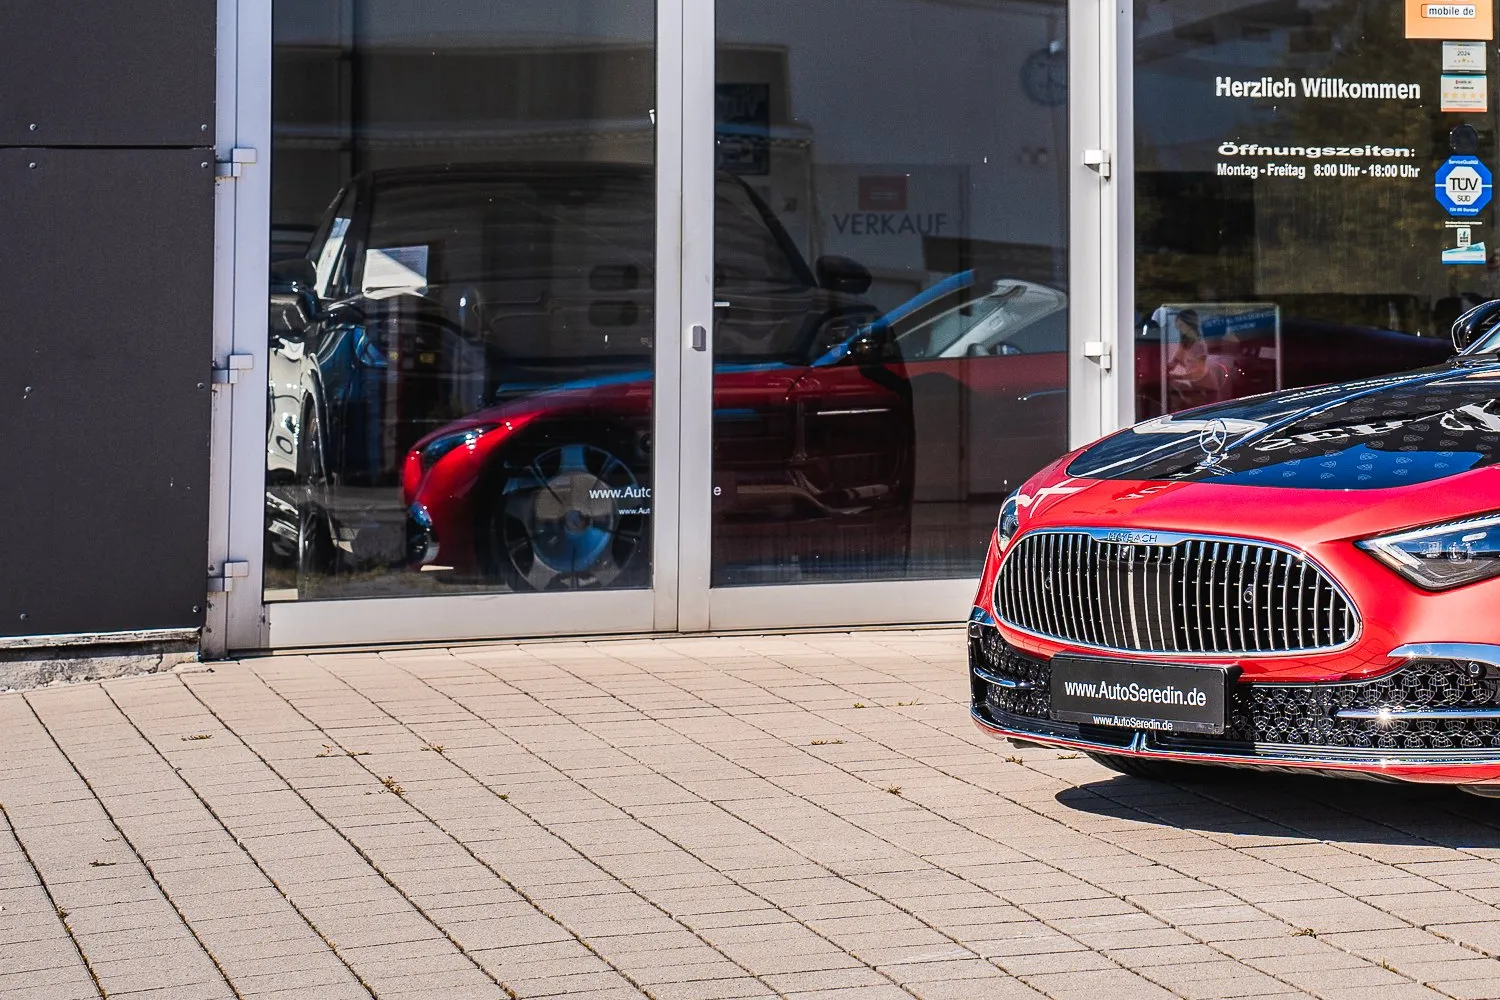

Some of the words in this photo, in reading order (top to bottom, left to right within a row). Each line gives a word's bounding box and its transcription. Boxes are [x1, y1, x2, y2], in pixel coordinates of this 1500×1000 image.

[1215, 76, 1296, 98] Herzlich
[1301, 77, 1421, 99] Willkommen
[1217, 142, 1415, 158] Öffnungszeiten:
[1217, 163, 1258, 179] Montag
[1267, 163, 1306, 179] Freitag
[1313, 164, 1337, 177] 8:00
[1339, 164, 1360, 177] Uhr
[1369, 164, 1398, 177] 18:00
[1400, 165, 1420, 178] Uhr
[1449, 177, 1478, 191] TÜV
[833, 213, 948, 236] VERKAUF
[1108, 531, 1158, 543] MAYBACH
[1065, 680, 1206, 707] www.AutoSeredin.de
[1093, 715, 1173, 731] www.AutoSeredin.de
